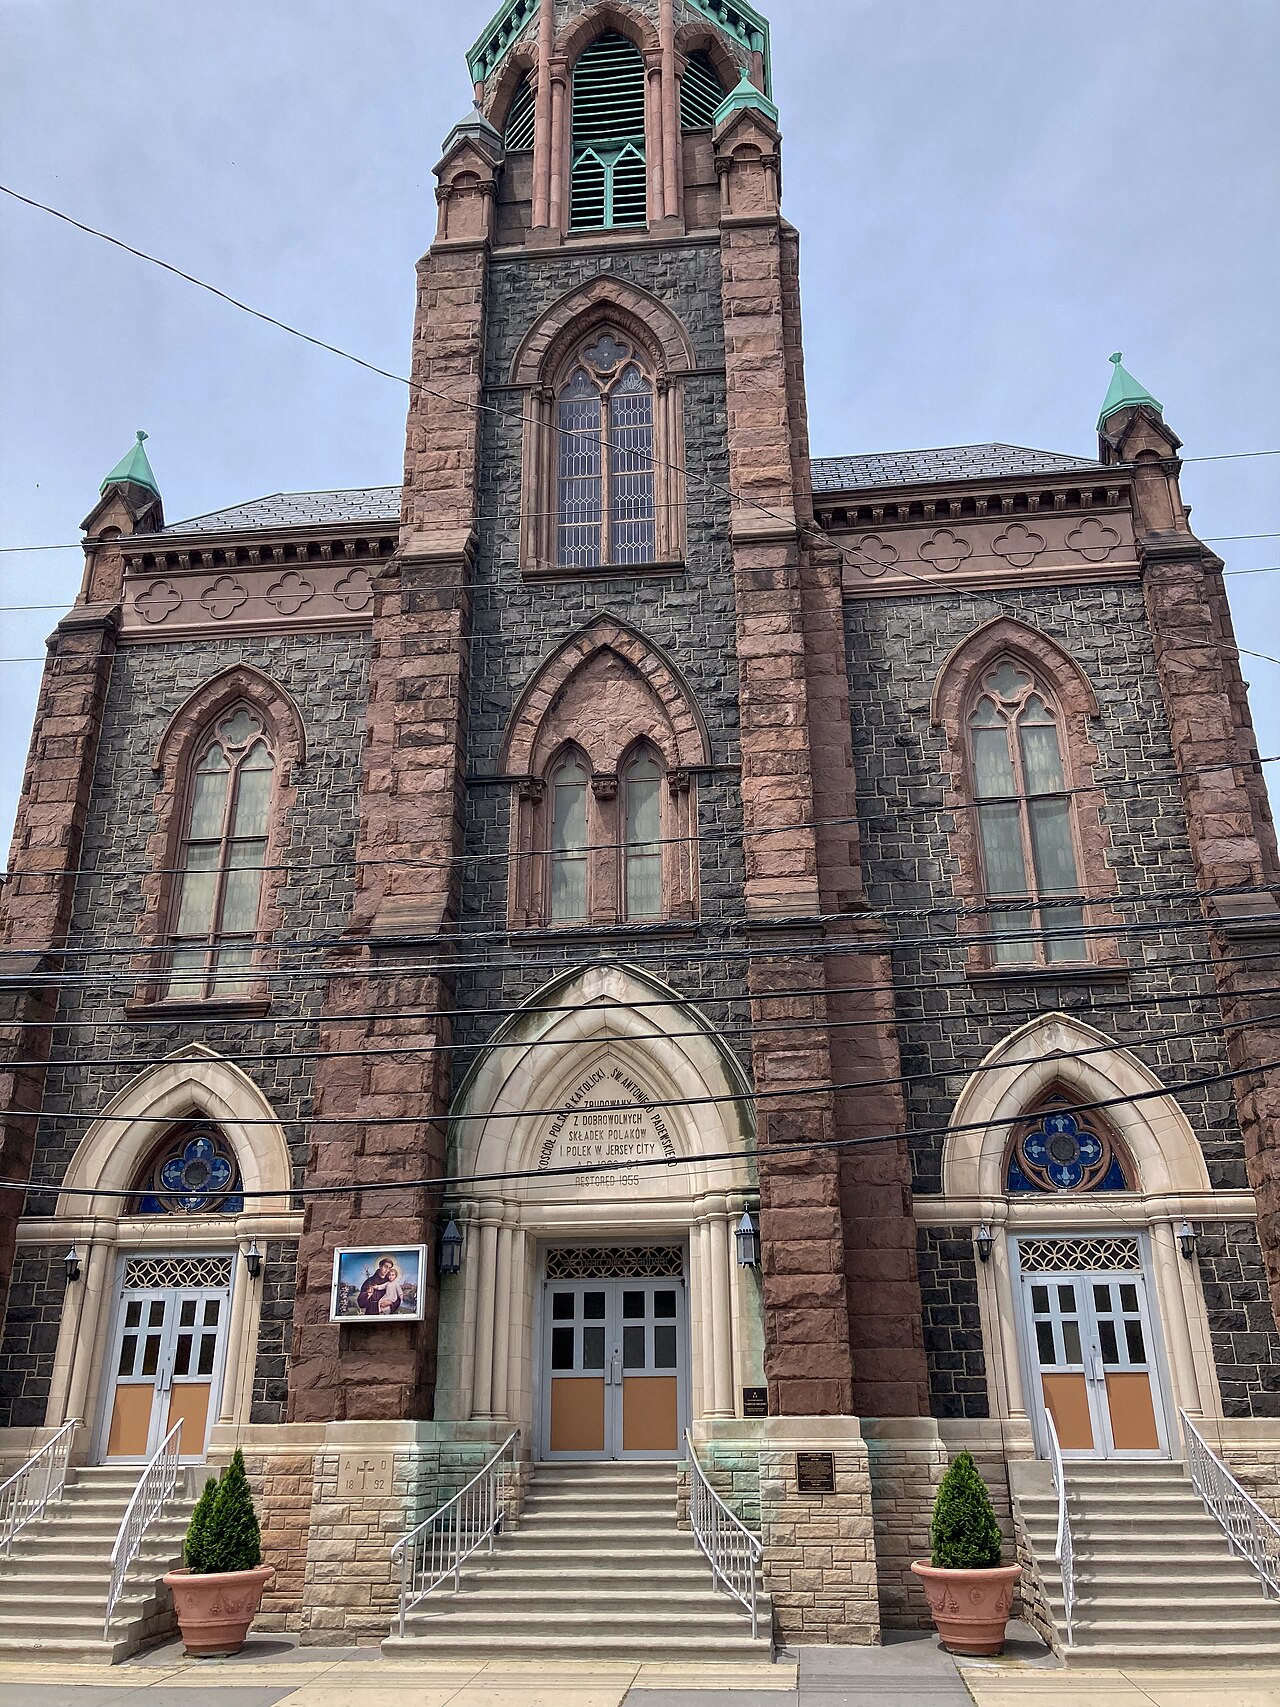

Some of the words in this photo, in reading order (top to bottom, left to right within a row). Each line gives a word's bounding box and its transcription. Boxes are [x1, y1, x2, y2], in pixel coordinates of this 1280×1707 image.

[549, 1111, 570, 1137] POLSK
[574, 1115, 578, 1126] Z
[583, 1113, 642, 1125] DOBROWOLNYCH
[620, 1077, 654, 1113] ANTONIEO
[651, 1114, 678, 1167] PADEWSKIEO
[569, 1130, 604, 1141] SKŁADEK
[609, 1127, 646, 1140] POLAKÓW
[566, 1145, 592, 1157] POLEK
[606, 1143, 633, 1155] JERSEY
[636, 1142, 655, 1154] CITY
[575, 1175, 615, 1187] RESTORED
[620, 1174, 639, 1186] 1955
[345, 1461, 351, 1470] A
[381, 1461, 386, 1470] D
[346, 1480, 354, 1489] 18
[374, 1480, 384, 1489] 92
